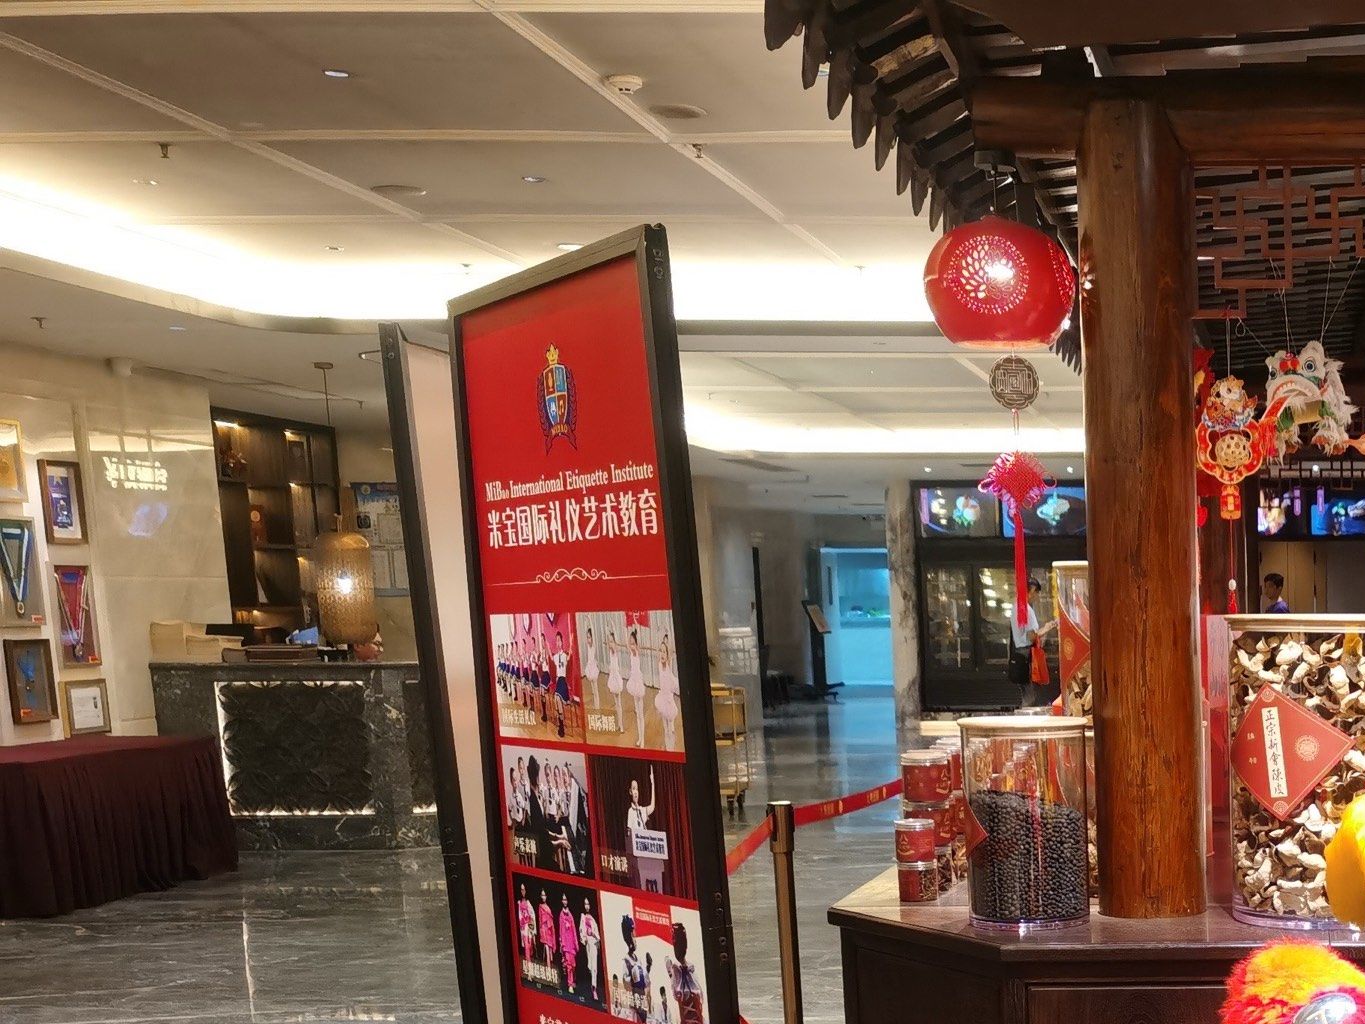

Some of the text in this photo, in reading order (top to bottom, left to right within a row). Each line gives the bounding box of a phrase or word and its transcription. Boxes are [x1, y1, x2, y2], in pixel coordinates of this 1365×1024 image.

[485, 460, 654, 502] MiBao International Etiquette Institute
[488, 488, 658, 549] 米宝国际礼仪艺术教育
